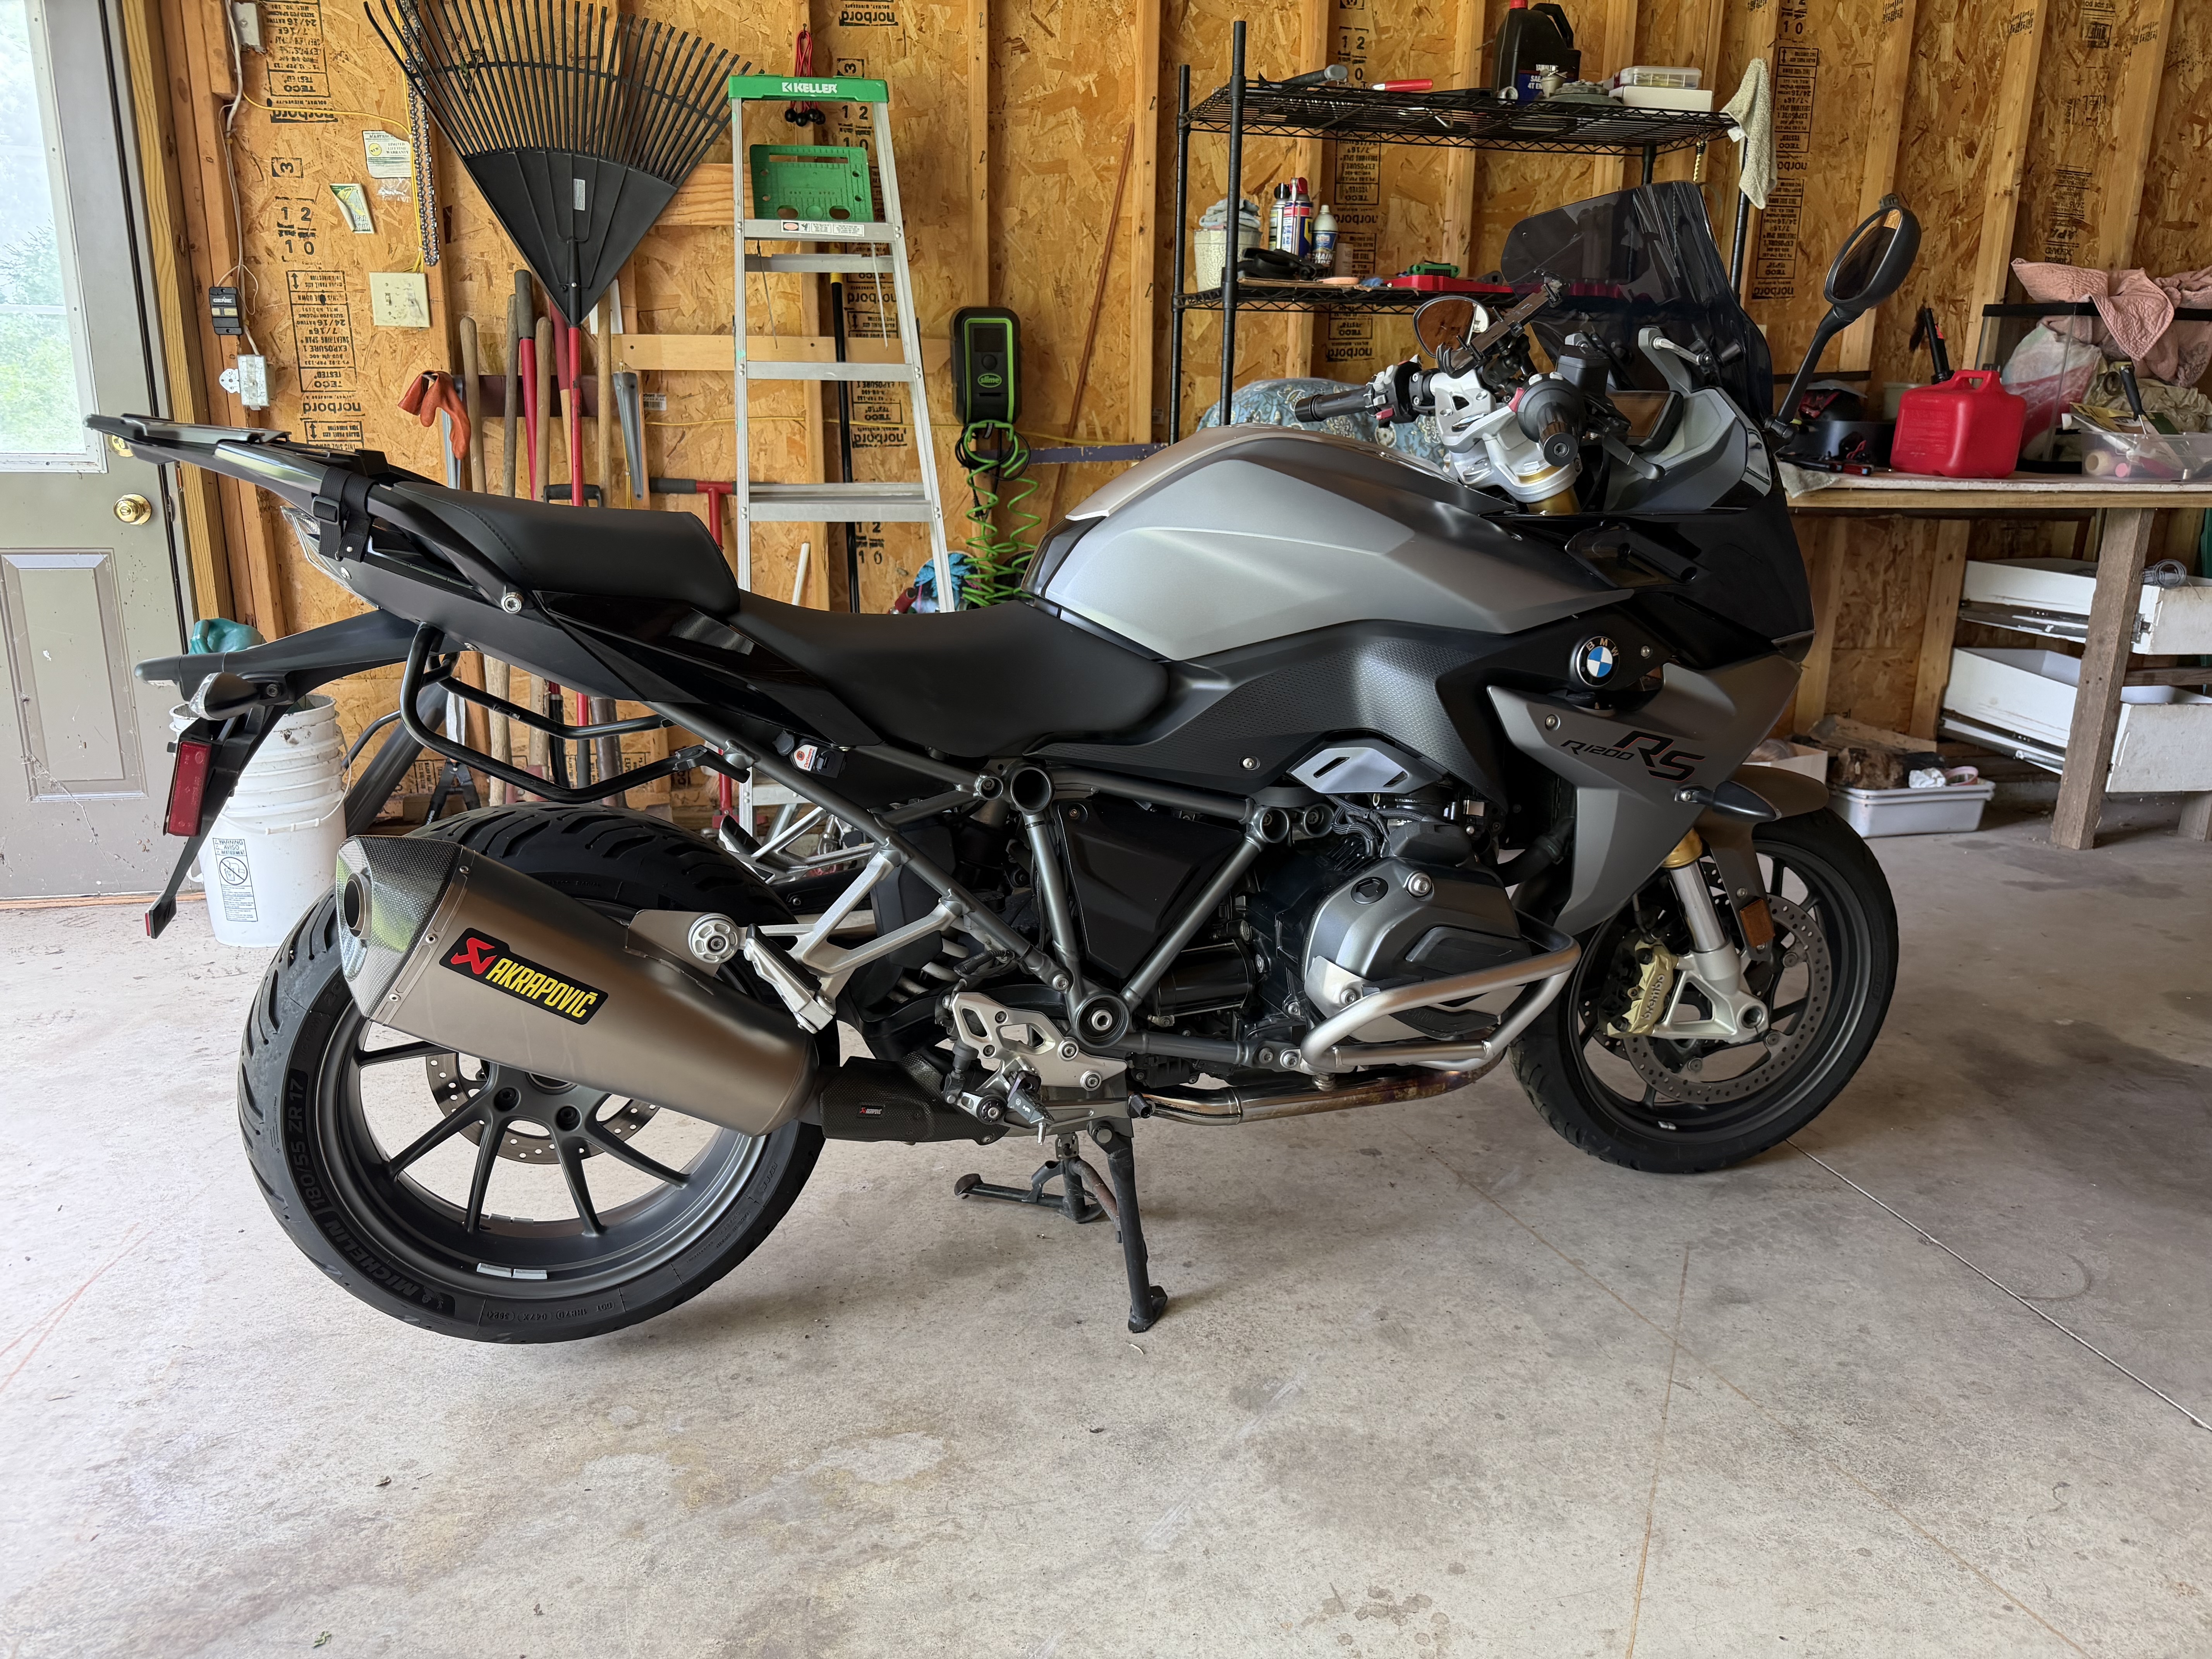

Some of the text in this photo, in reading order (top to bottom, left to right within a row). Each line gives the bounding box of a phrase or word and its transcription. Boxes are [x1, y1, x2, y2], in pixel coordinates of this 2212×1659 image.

[842, 11, 895, 23] norbord
[793, 82, 837, 93] KELLER
[303, 402, 361, 414] norbord
[1586, 637, 1620, 657] BMW
[1613, 730, 1705, 782] RS
[485, 958, 598, 1018] AKRAPOVIČ
[1640, 974, 1665, 1021] brembo
[290, 1078, 305, 1103] 17
[288, 1108, 304, 1133] ZR
[324, 1218, 418, 1296] MICHELIN
